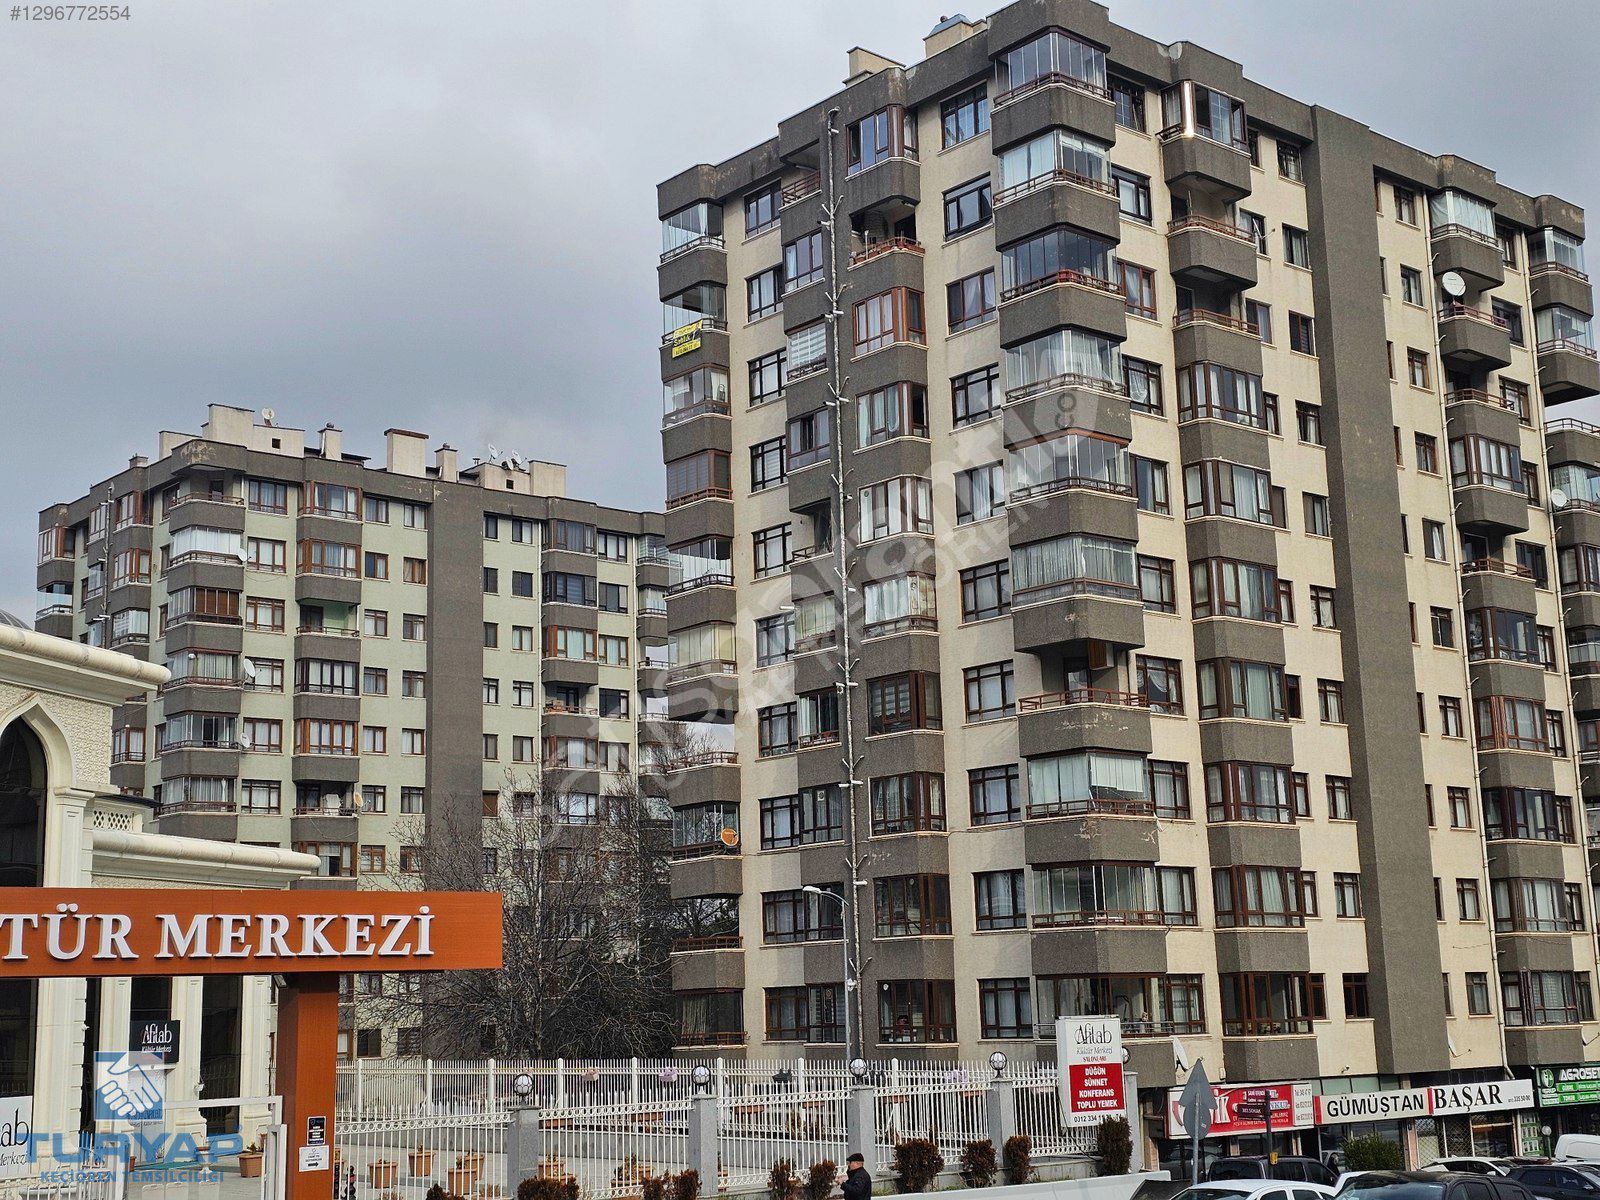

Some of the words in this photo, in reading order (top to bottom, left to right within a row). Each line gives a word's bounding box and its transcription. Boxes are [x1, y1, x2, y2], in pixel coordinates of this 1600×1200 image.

[155, 905, 435, 958] MERKEZİ
[1085, 1066, 1106, 1075] DÜĞÜN
[1084, 1077, 1108, 1086] SÜNNET
[1079, 1089, 1115, 1098] KONFERANS
[1433, 1084, 1503, 1112] BAŞAR
[1077, 1101, 1097, 1109] TOPLU
[1098, 1100, 1117, 1108] YEMEK
[1327, 1094, 1424, 1117] GÜMÜŞTAN
